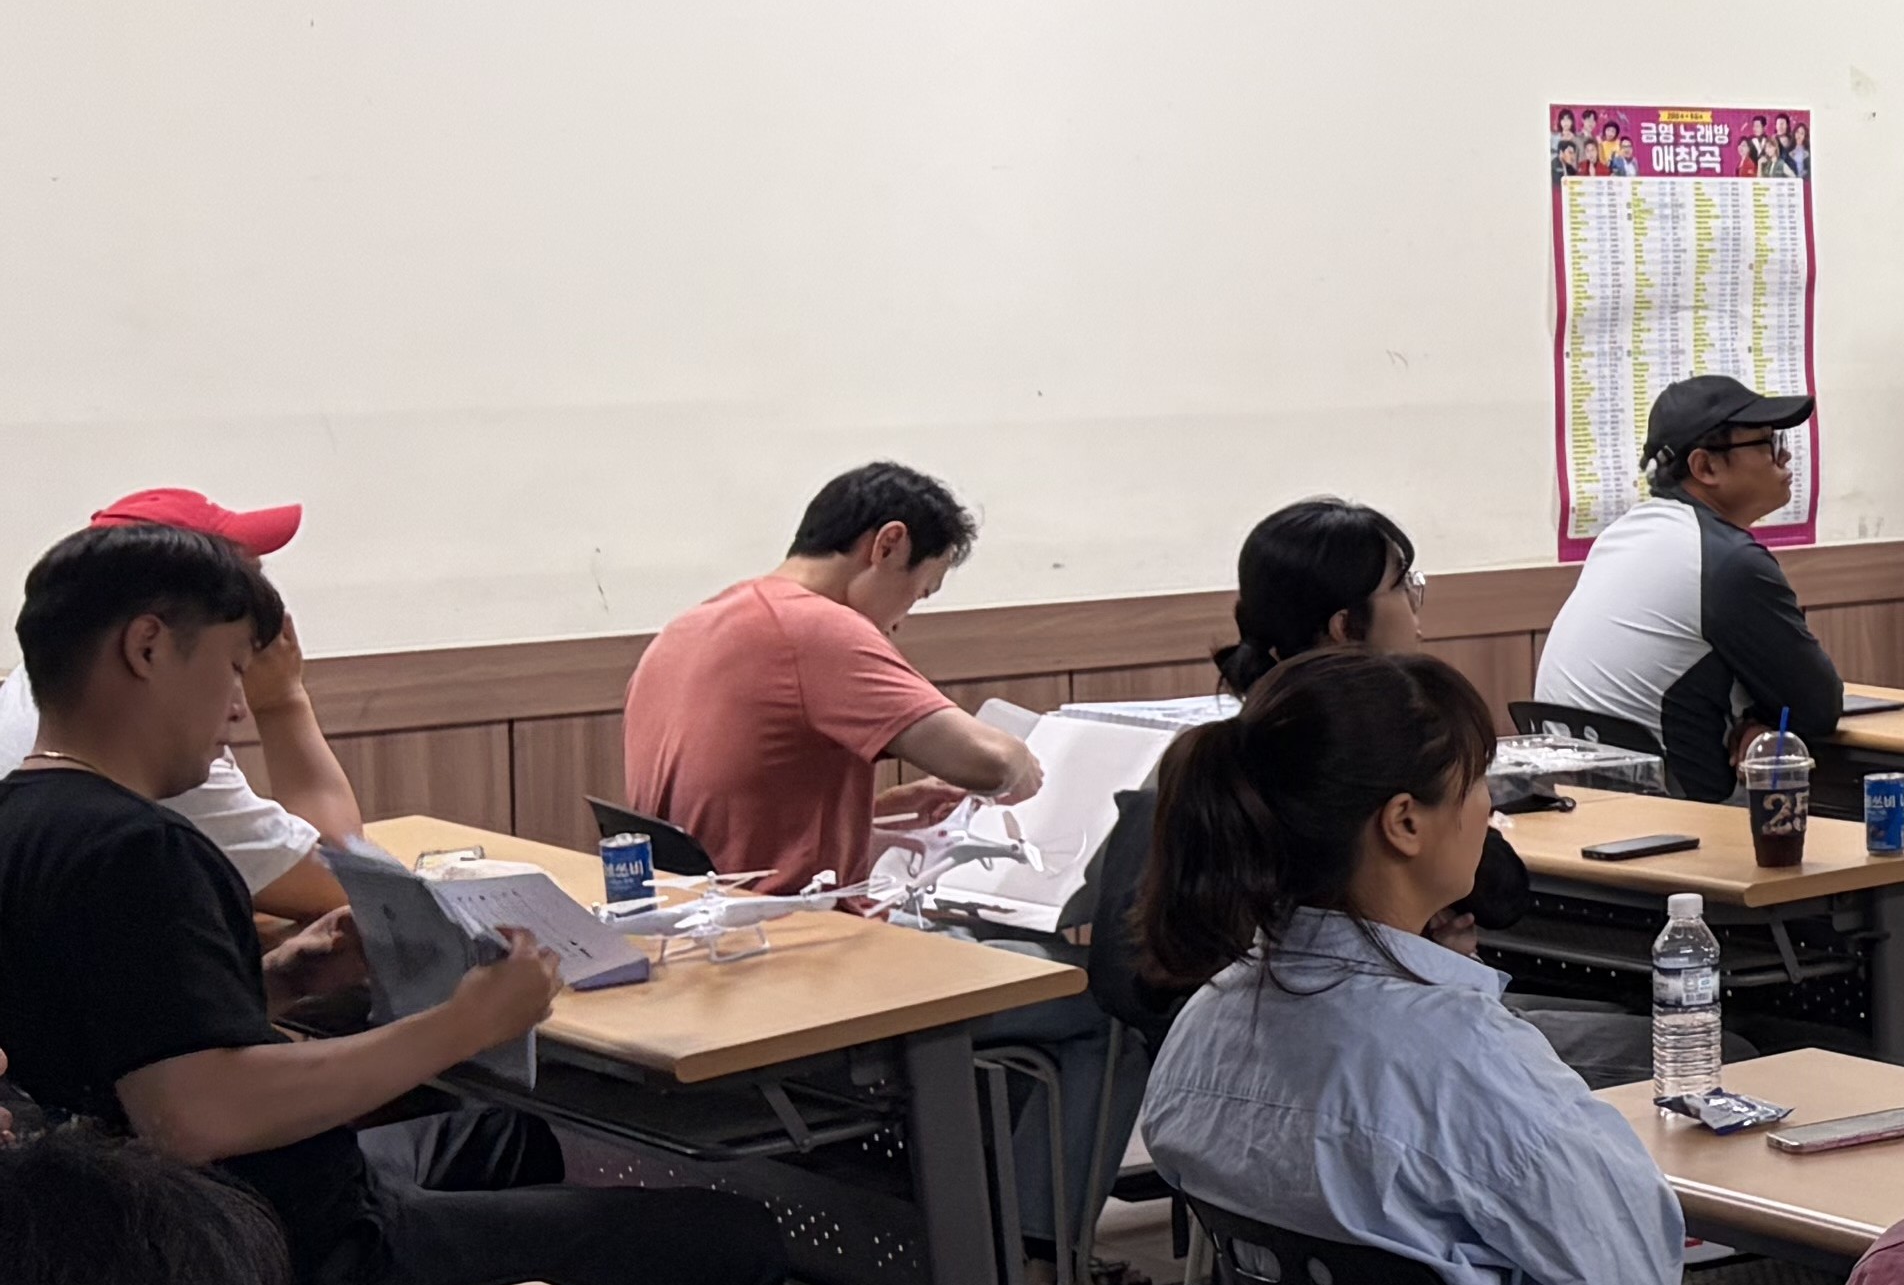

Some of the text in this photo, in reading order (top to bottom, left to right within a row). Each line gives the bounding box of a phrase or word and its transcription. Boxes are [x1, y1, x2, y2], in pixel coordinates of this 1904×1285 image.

[1640, 122, 1730, 145] 금영 노래방
[1651, 144, 1722, 174] 애창곡
